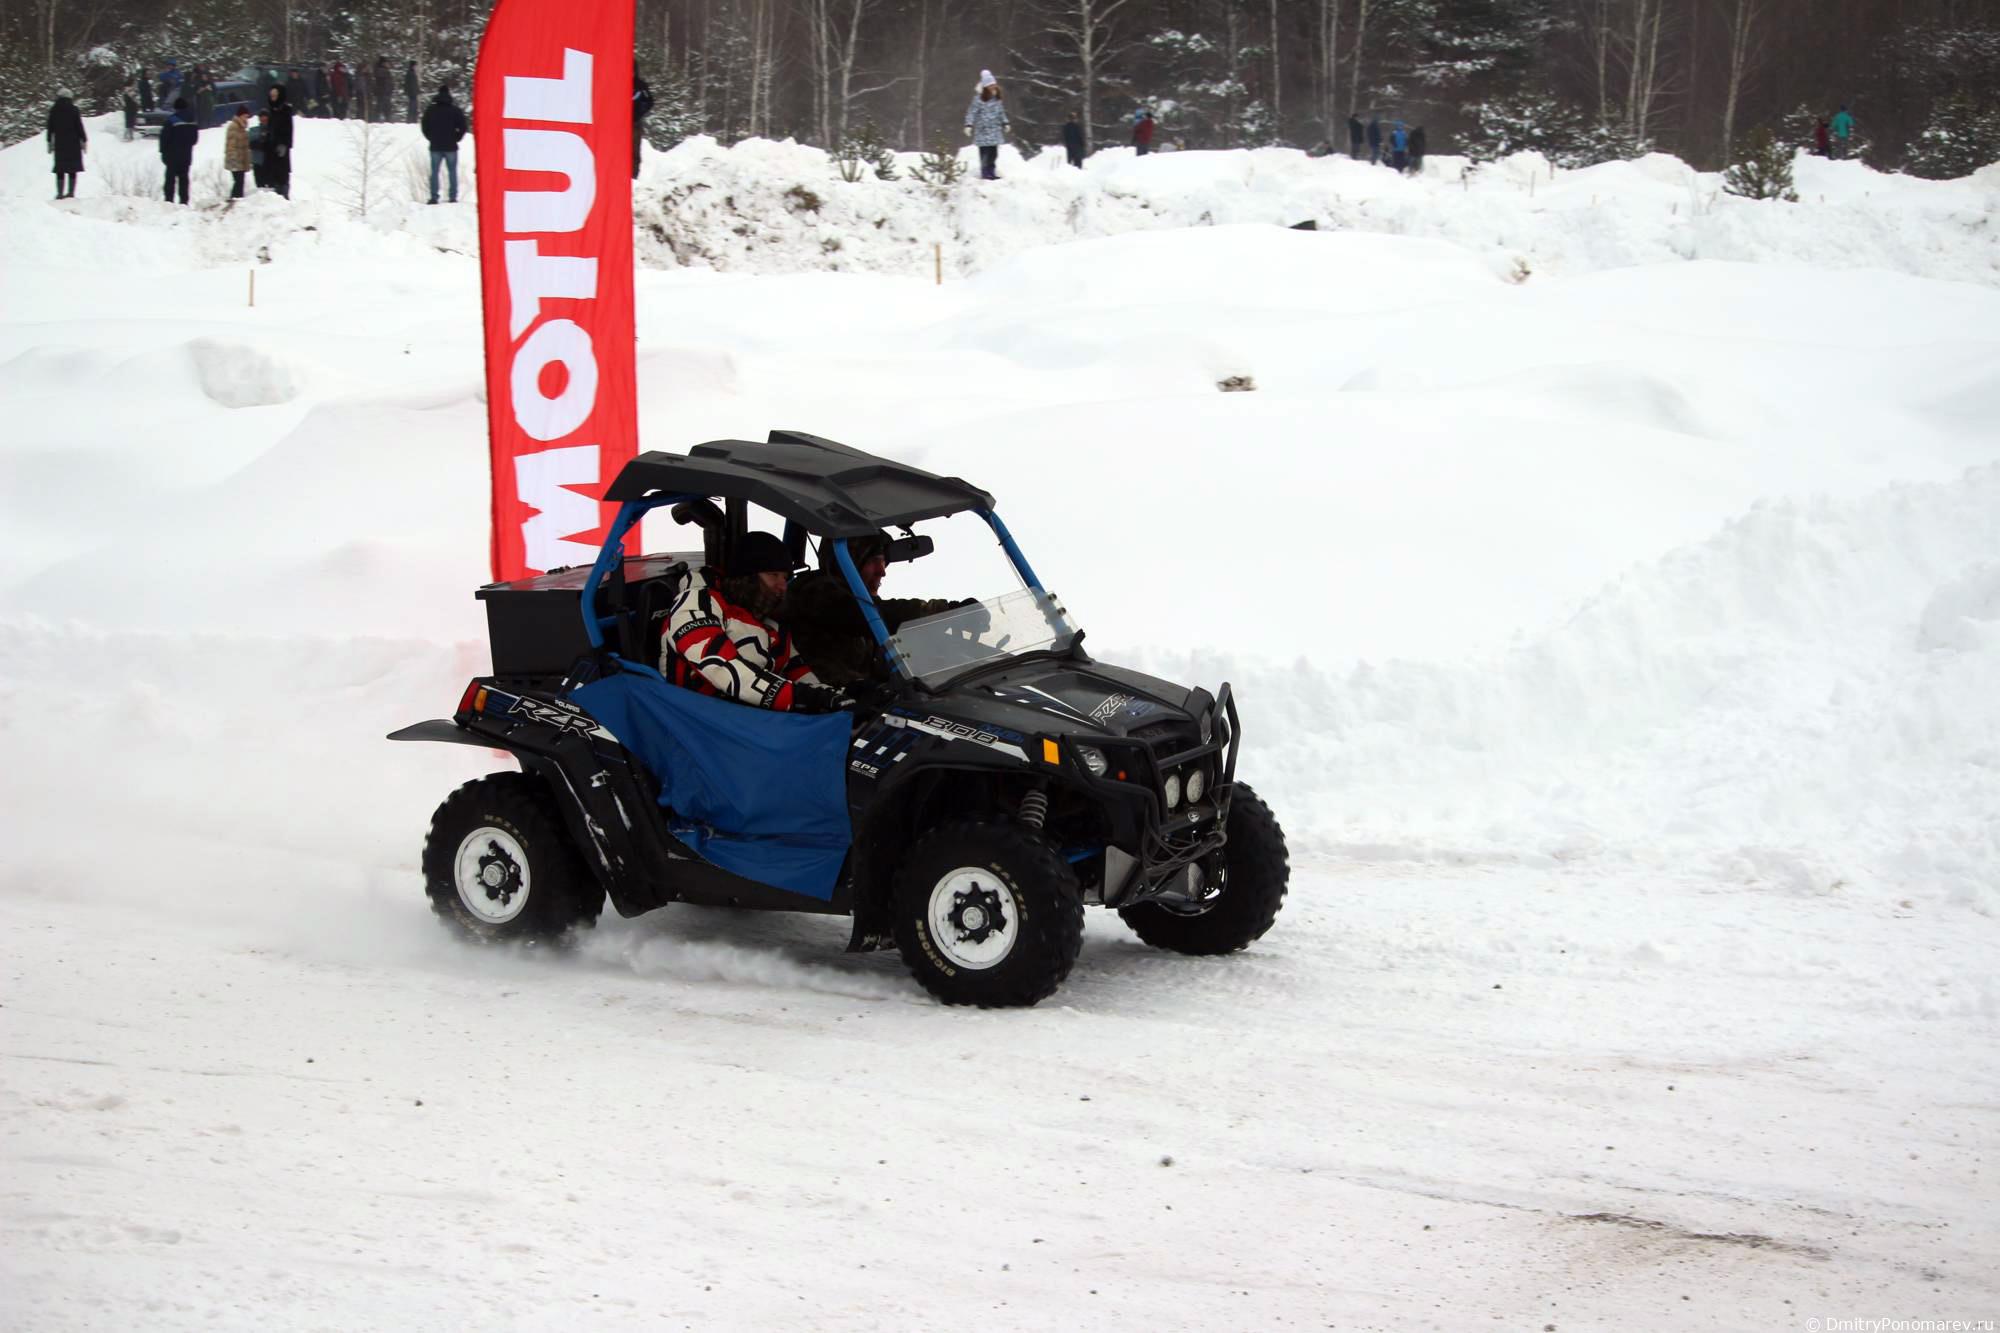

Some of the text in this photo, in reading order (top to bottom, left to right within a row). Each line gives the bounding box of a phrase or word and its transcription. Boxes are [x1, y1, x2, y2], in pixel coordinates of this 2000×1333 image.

[503, 47, 600, 574] MOTUL
[508, 696, 600, 741] RZR
[923, 714, 999, 747] 800
[851, 760, 880, 774] EPS
